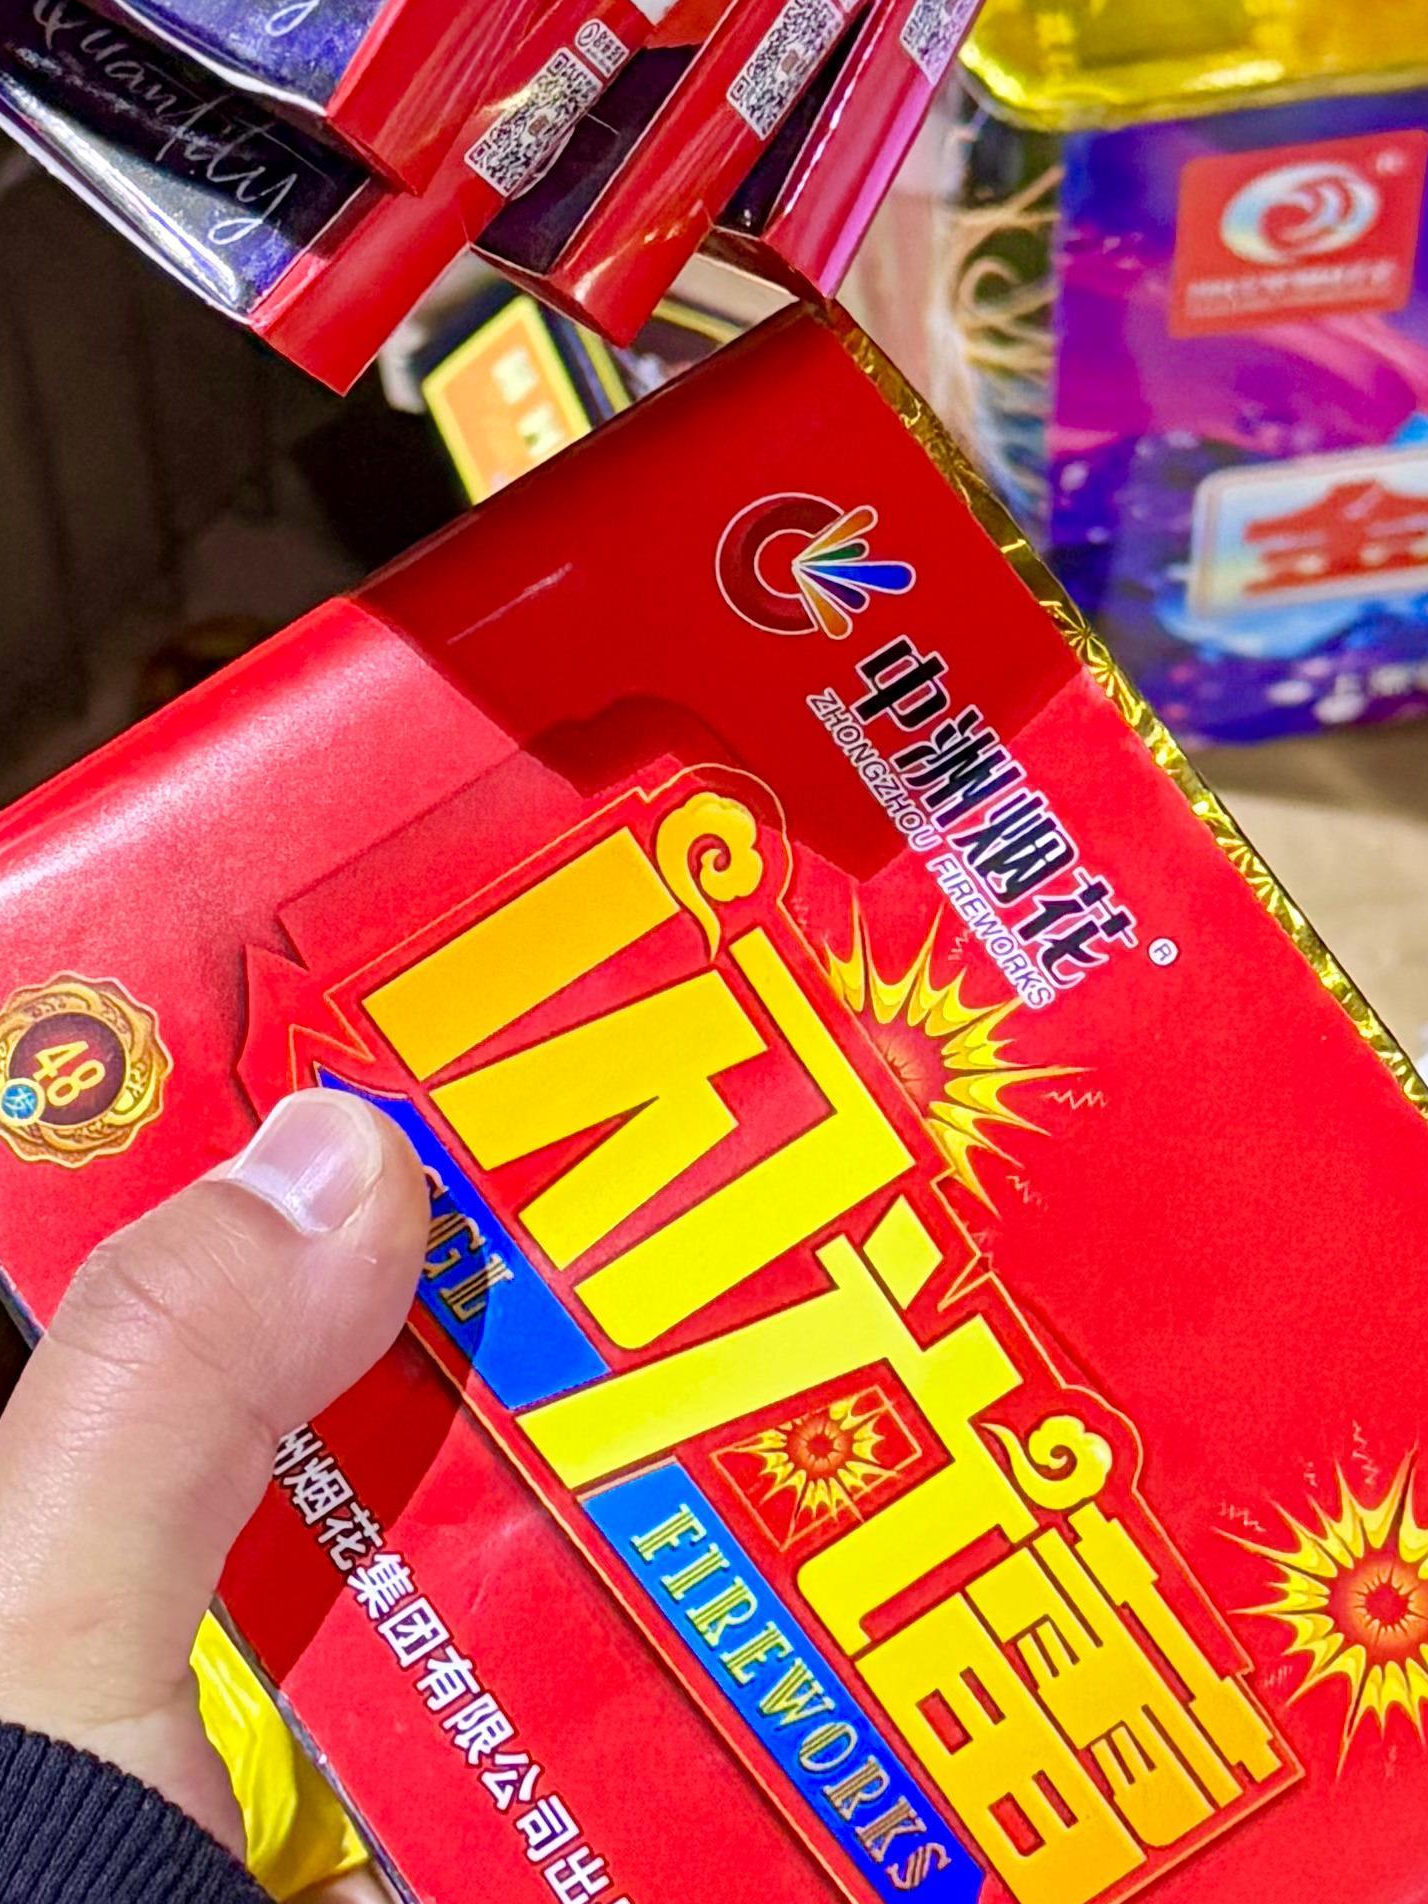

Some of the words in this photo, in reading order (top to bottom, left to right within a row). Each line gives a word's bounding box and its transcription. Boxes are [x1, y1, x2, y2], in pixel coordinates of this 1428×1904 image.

[808, 689, 939, 853] ZHONGZHOU
[926, 855, 1055, 1011] FIREWORKS
[855, 636, 1138, 990] 中洲烟花
[32, 1038, 106, 1109] 48
[426, 1162, 515, 1325] GL
[630, 1503, 953, 1891] FIREWORKS
